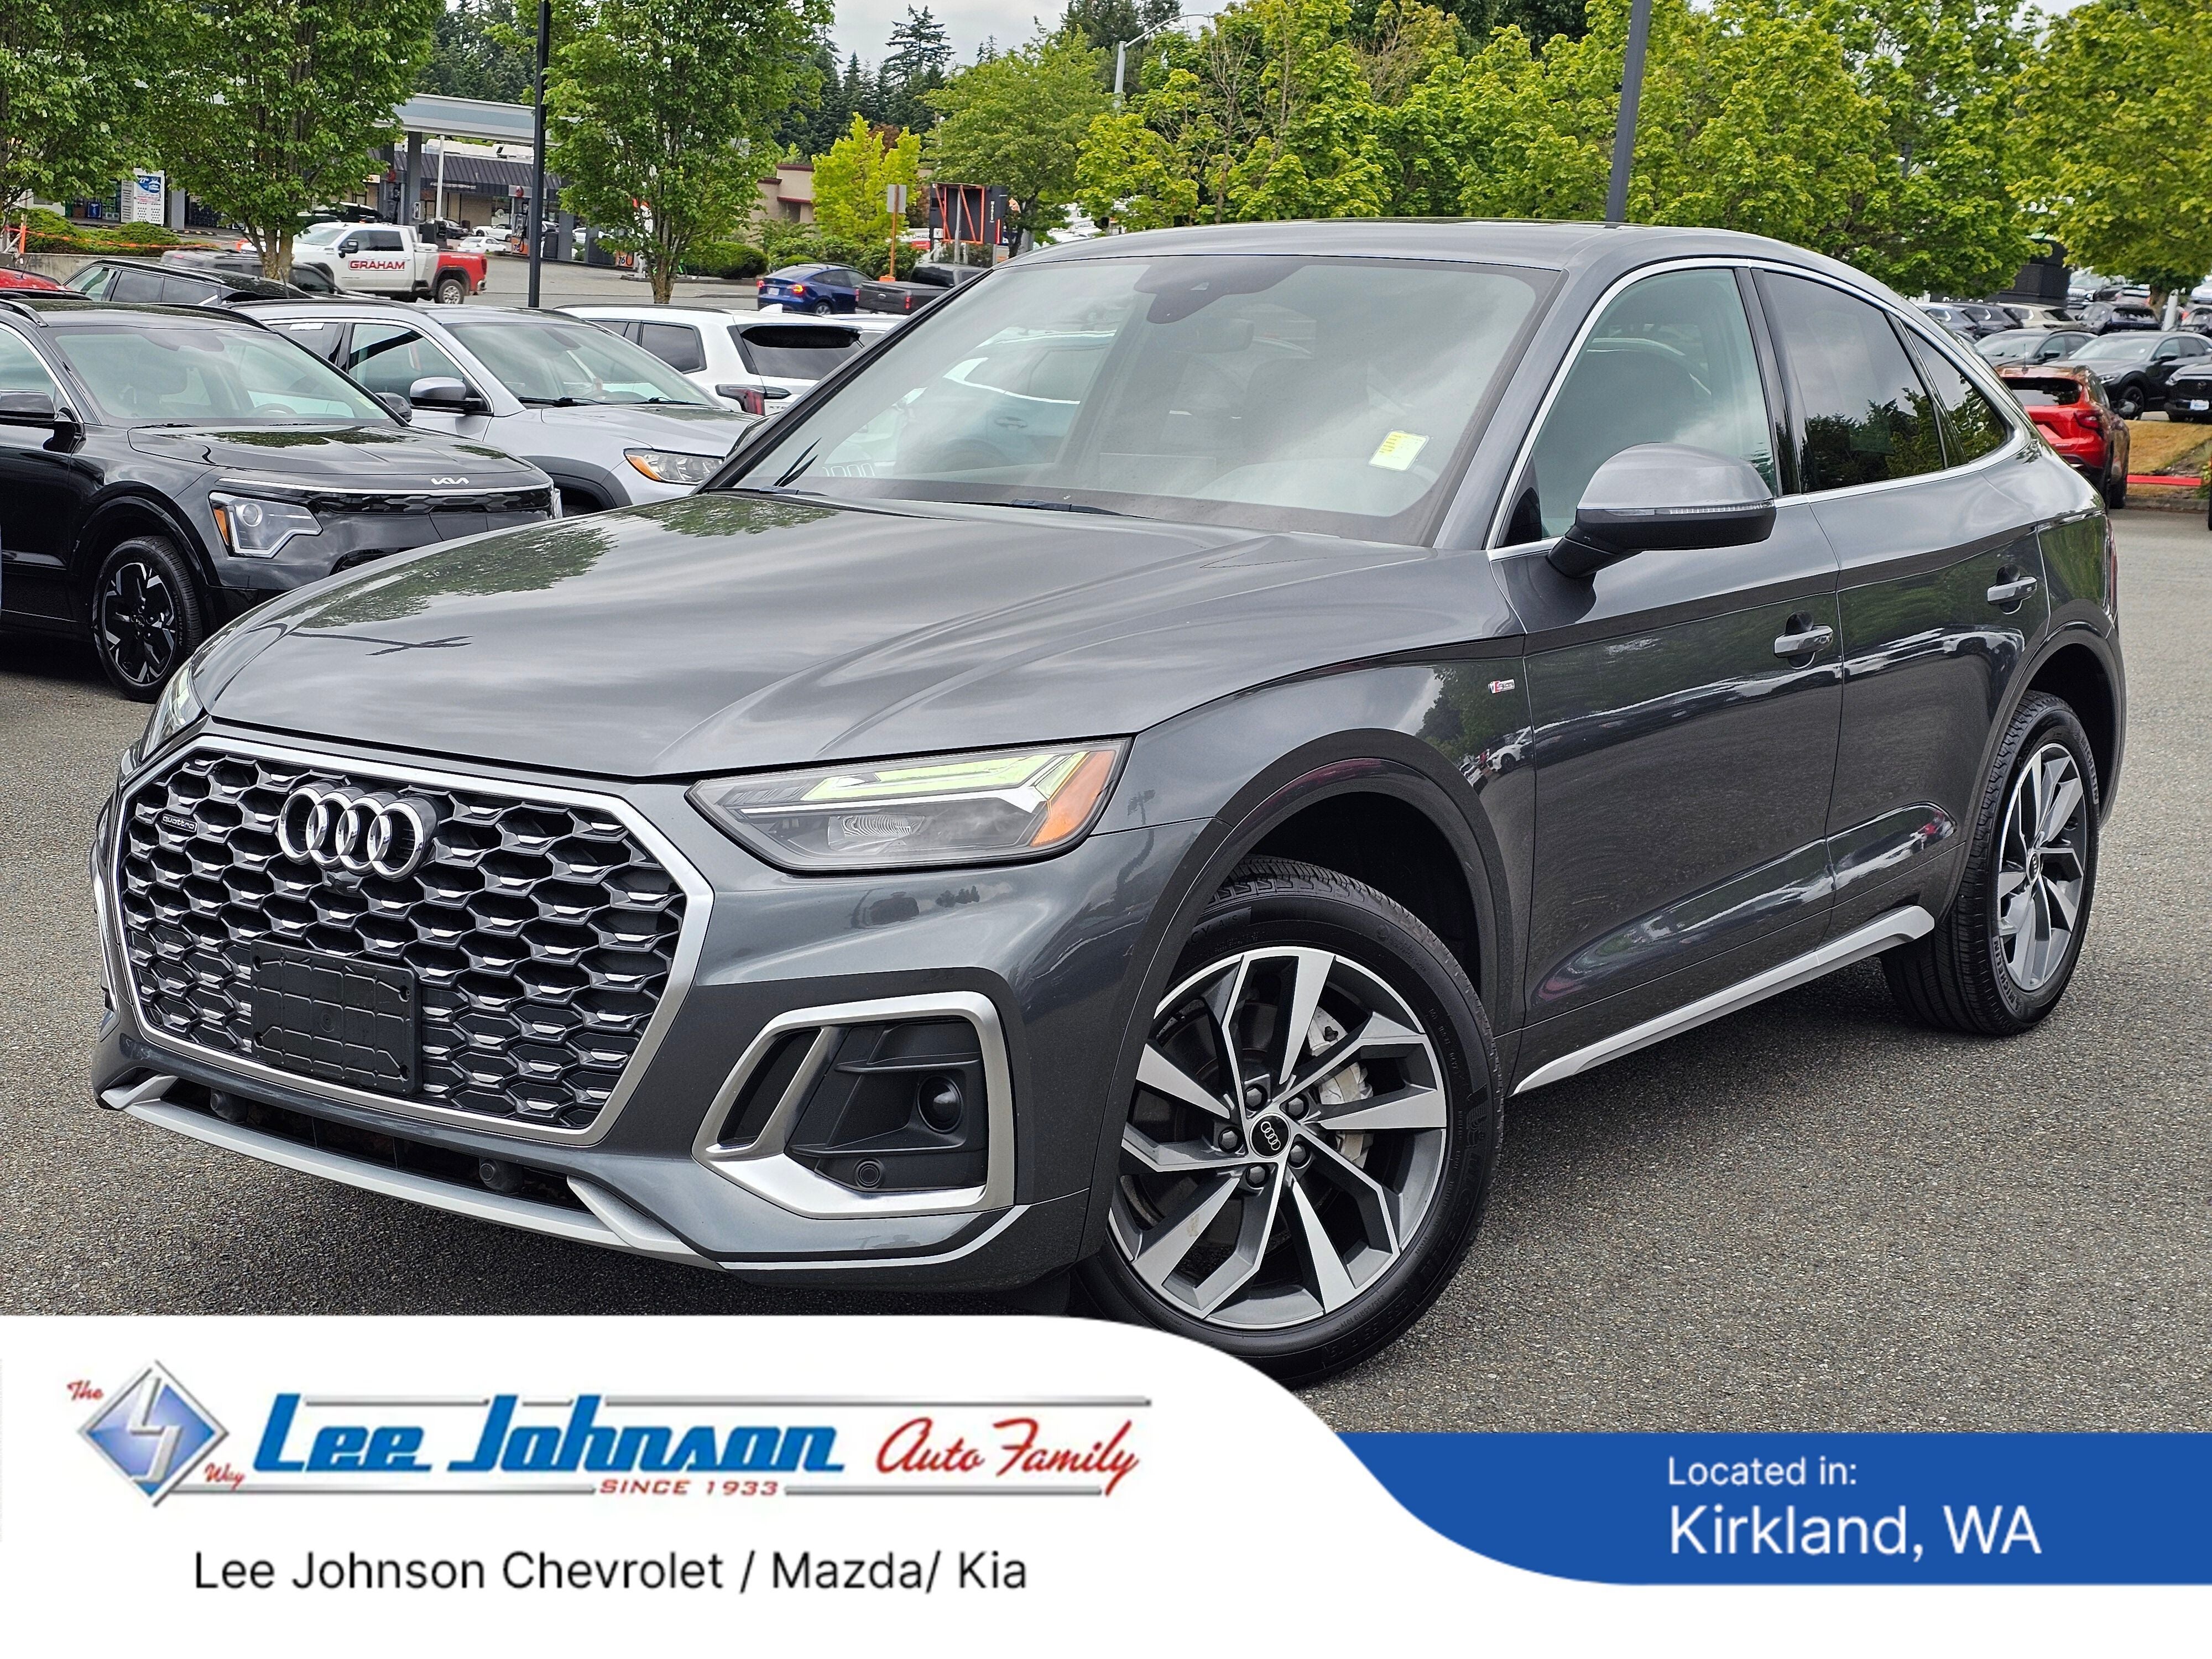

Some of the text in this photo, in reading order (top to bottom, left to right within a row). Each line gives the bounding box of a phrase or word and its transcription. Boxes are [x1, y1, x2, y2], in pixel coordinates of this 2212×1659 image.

[349, 260, 405, 270] GRAHAM
[618, 256, 625, 264] 76
[2080, 737, 2098, 800] MICHELIN
[162, 816, 195, 830] quattro
[1994, 940, 2016, 1004] MICHELIN
